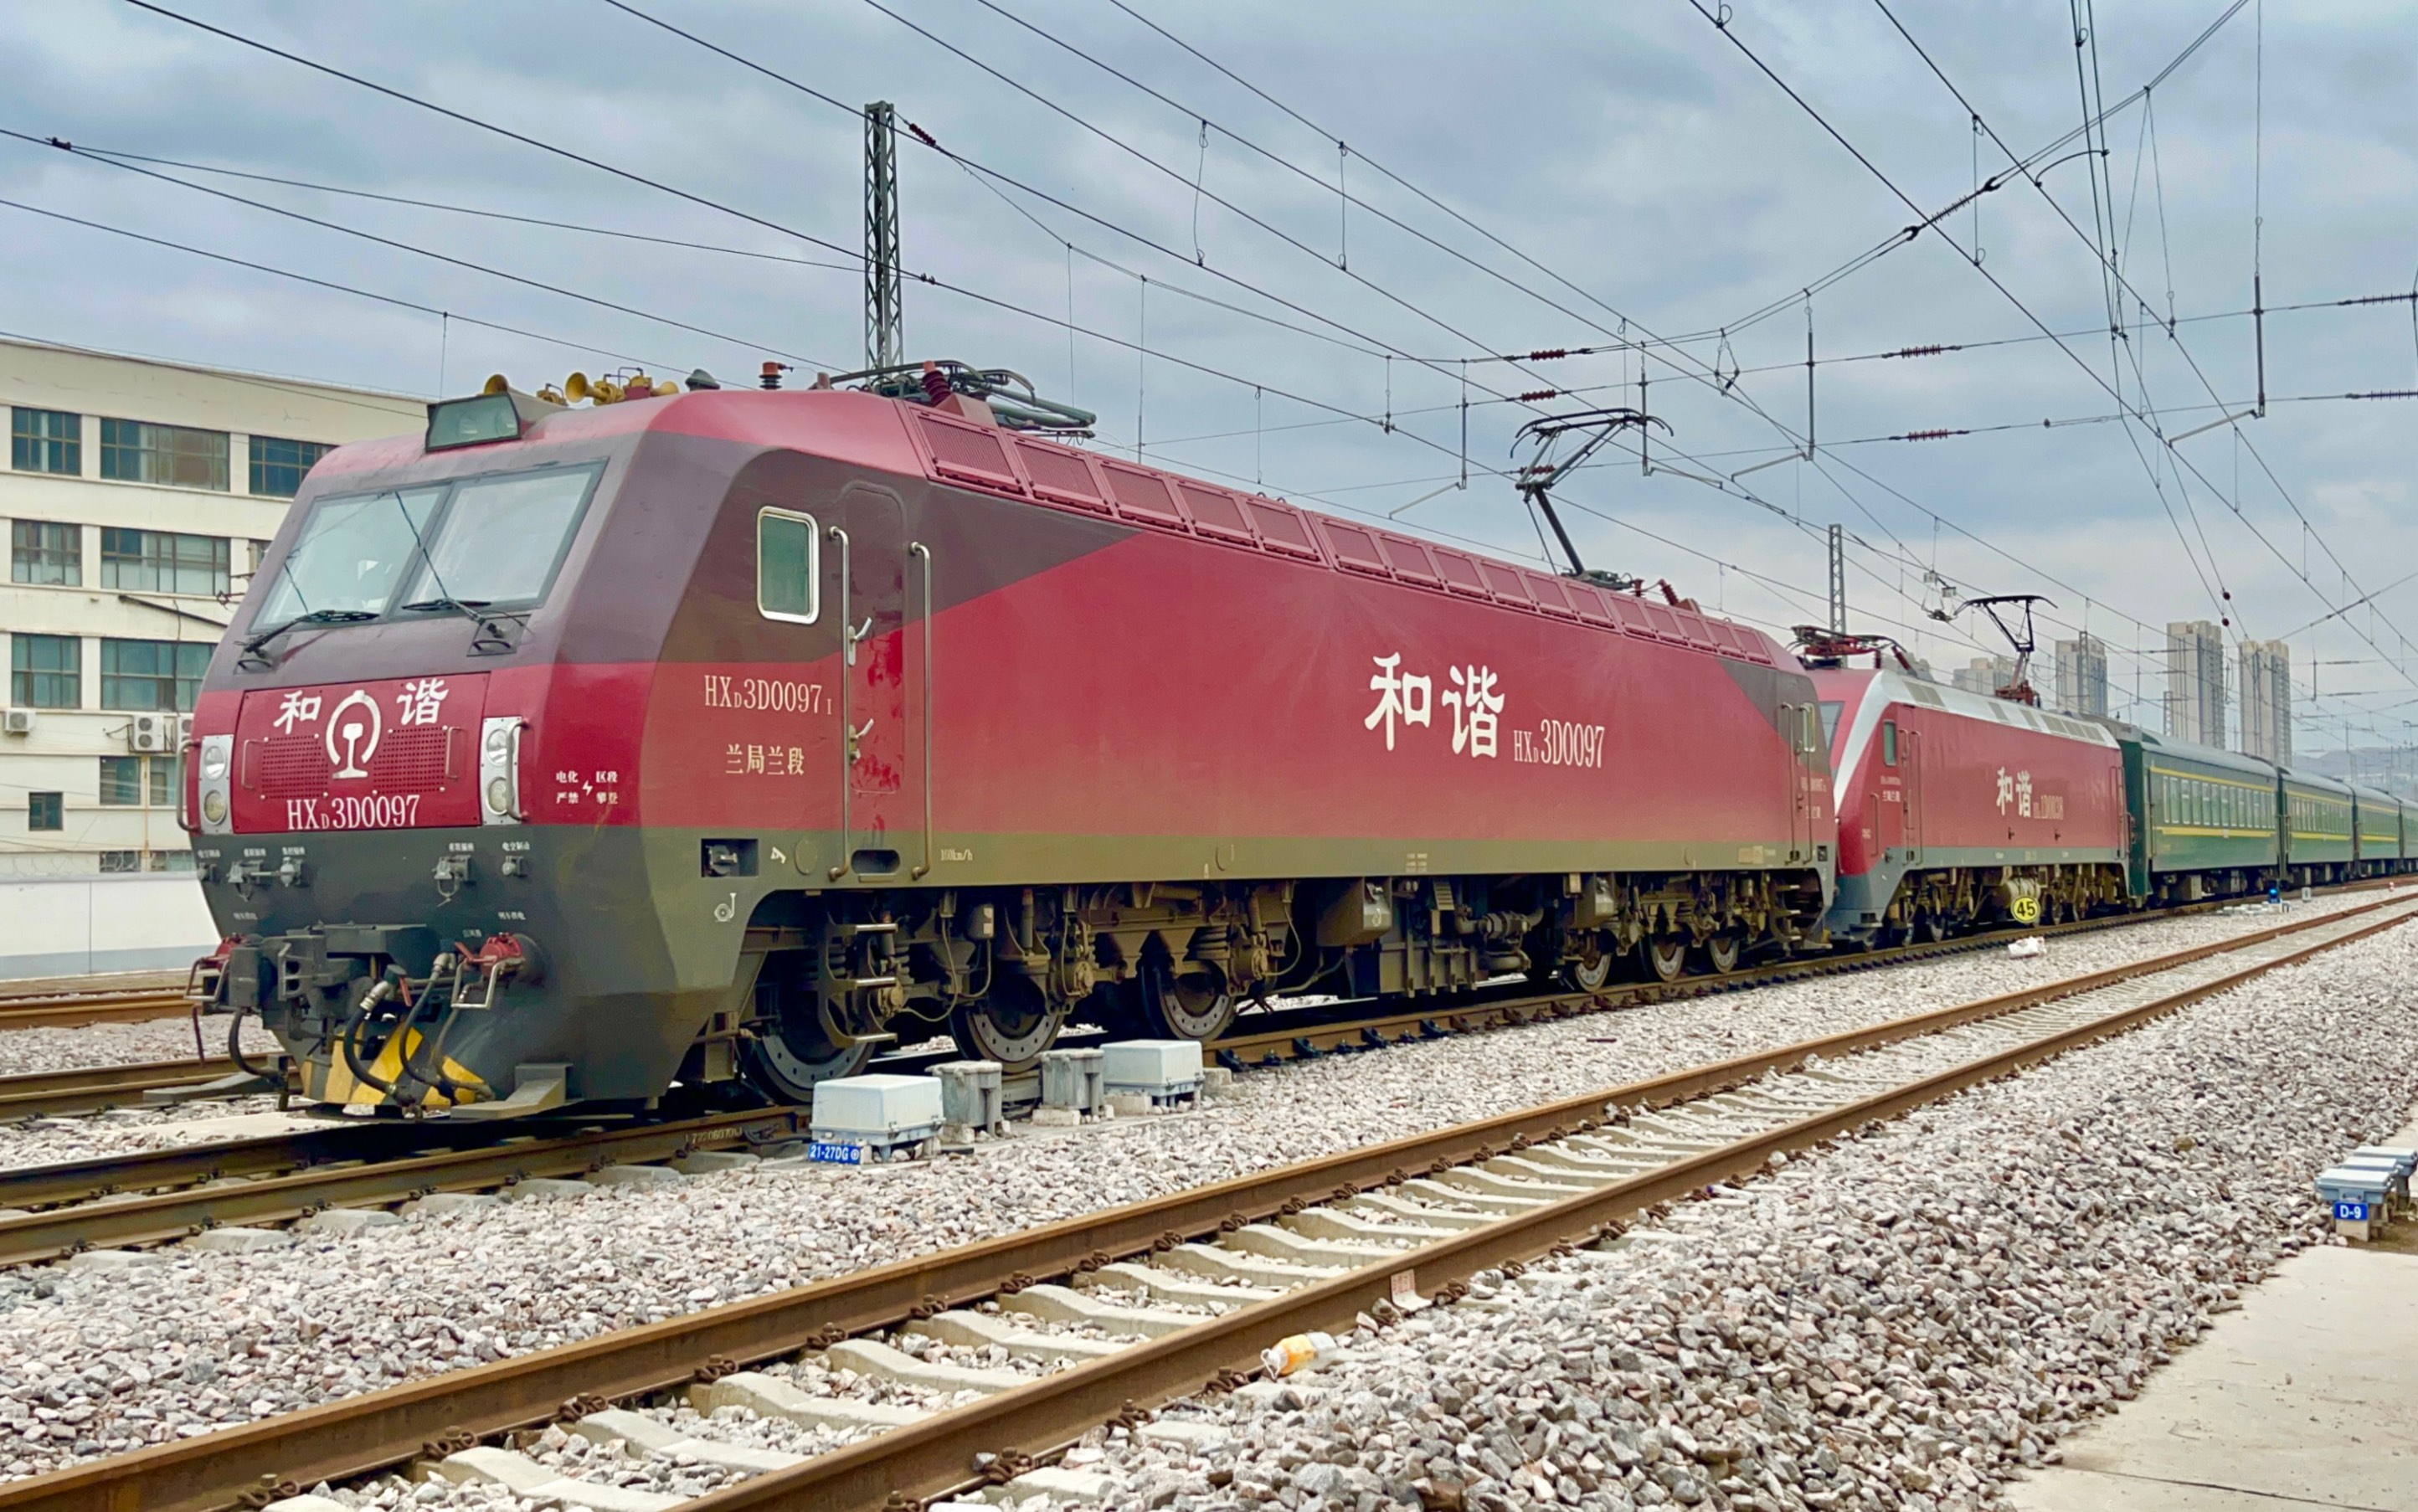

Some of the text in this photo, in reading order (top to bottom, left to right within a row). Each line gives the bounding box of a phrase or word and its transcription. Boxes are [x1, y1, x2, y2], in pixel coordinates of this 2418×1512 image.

[274, 678, 449, 734] 和 谐
[703, 675, 822, 714] HXD3D0097
[1364, 651, 1505, 758] 和谐
[725, 743, 805, 776] 兰局兰段
[1513, 718, 1606, 769] HXD3D0097
[556, 770, 618, 783] 电化 区段
[1996, 766, 2032, 817] 和谐
[286, 794, 420, 831] HXD3D0097
[556, 791, 579, 804] 严禁
[2017, 901, 2036, 917] 45
[810, 1144, 849, 1161] 21-27DG
[2339, 1205, 2362, 1219] D-9
